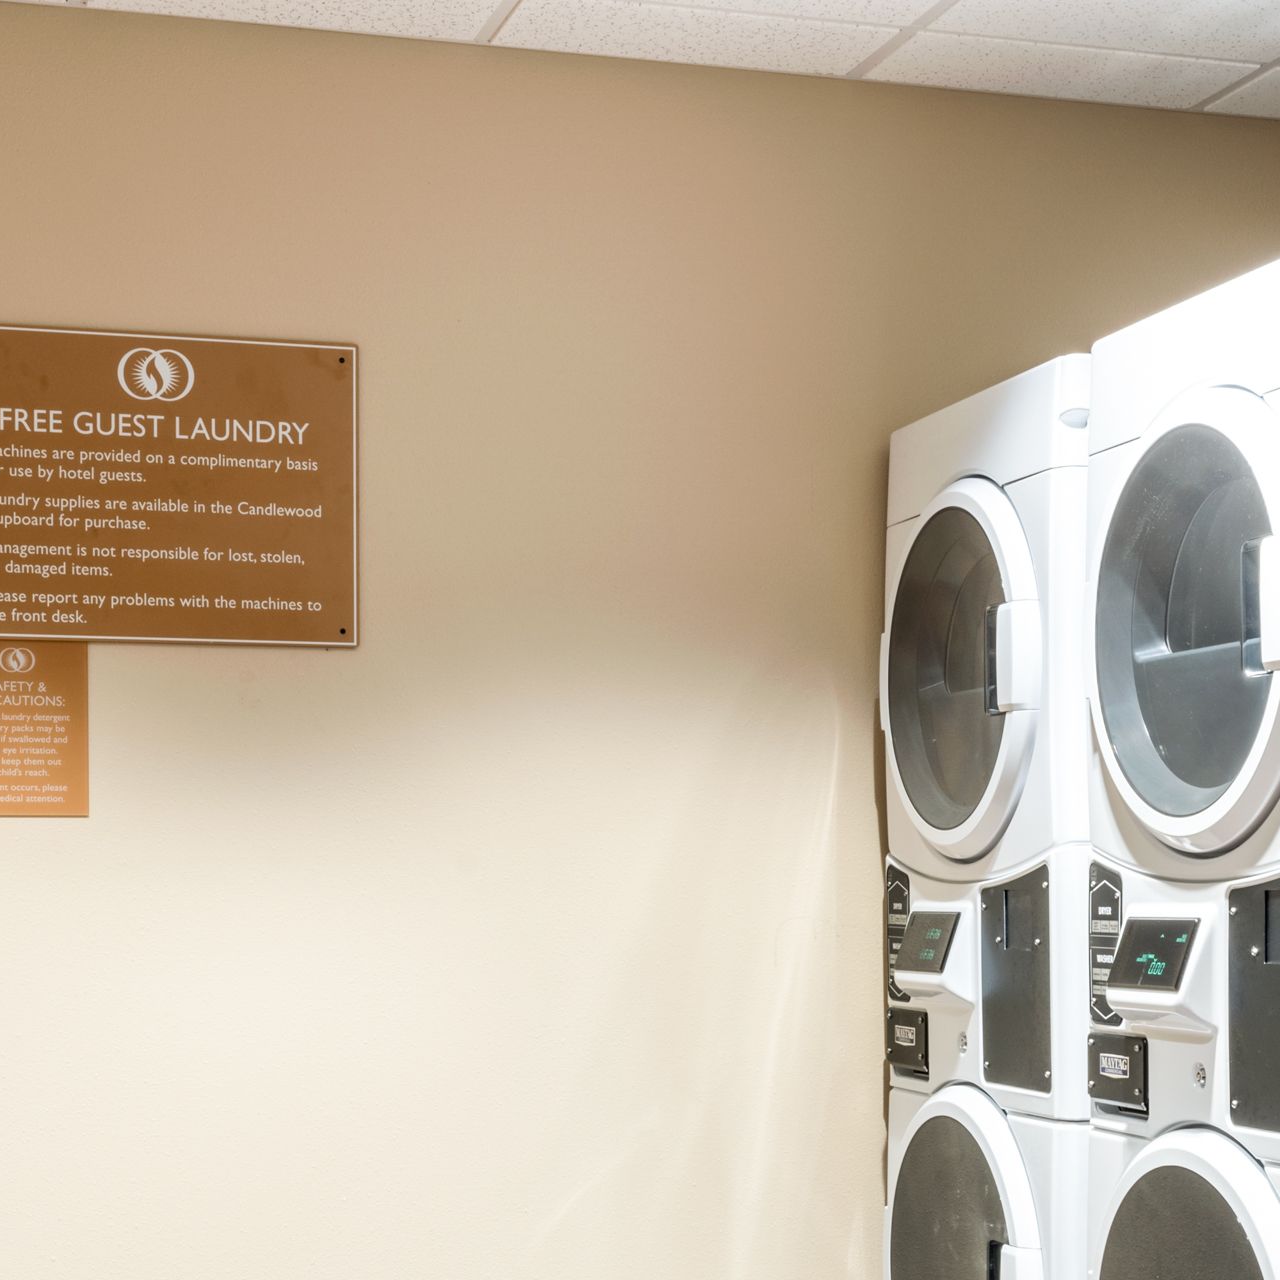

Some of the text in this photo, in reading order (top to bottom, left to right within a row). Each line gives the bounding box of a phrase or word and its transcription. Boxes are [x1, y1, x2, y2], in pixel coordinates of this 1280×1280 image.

[0, 408, 309, 445] FREE GUEST LAUNDRY
[52, 450, 74, 460] are
[80, 449, 140, 464] provided
[146, 454, 163, 464] on
[168, 455, 176, 464] a
[180, 453, 282, 473] complimentary
[286, 457, 318, 471] basis
[9, 467, 32, 477] use
[38, 464, 54, 482] by
[59, 465, 94, 480] hotel
[99, 471, 146, 484] guests.
[45, 495, 100, 510] supplies
[105, 500, 127, 510] are
[132, 498, 189, 512] available
[194, 500, 206, 513] in
[210, 501, 232, 514] the
[237, 501, 322, 518] Candlewood
[58, 513, 80, 527] for
[85, 516, 150, 531] purchase.
[77, 544, 87, 556] is
[92, 547, 116, 557] not
[121, 546, 199, 562] responsible
[203, 547, 224, 561] for
[228, 548, 257, 564] lost,
[260, 550, 305, 565] stolen,
[5, 561, 66, 577] damaged
[72, 563, 112, 576] items.
[32, 593, 78, 608] report
[82, 595, 106, 608] any
[111, 593, 175, 609] problems
[180, 595, 209, 608] with
[214, 595, 236, 608] the
[241, 597, 303, 611] machines
[307, 601, 322, 612] to
[11, 608, 47, 622] front
[52, 610, 87, 623] desk.
[38, 682, 46, 693] &
[1, 713, 31, 722] laundry
[32, 714, 70, 723] detergent
[11, 724, 34, 734] packs
[36, 726, 53, 734] may
[55, 724, 65, 733] be
[53, 736, 68, 744] and
[2, 748, 17, 756] eye
[1, 757, 22, 768] keep
[23, 758, 45, 766] them
[42, 784, 68, 793] please
[1101, 1056, 1128, 1071] MAYTAG
